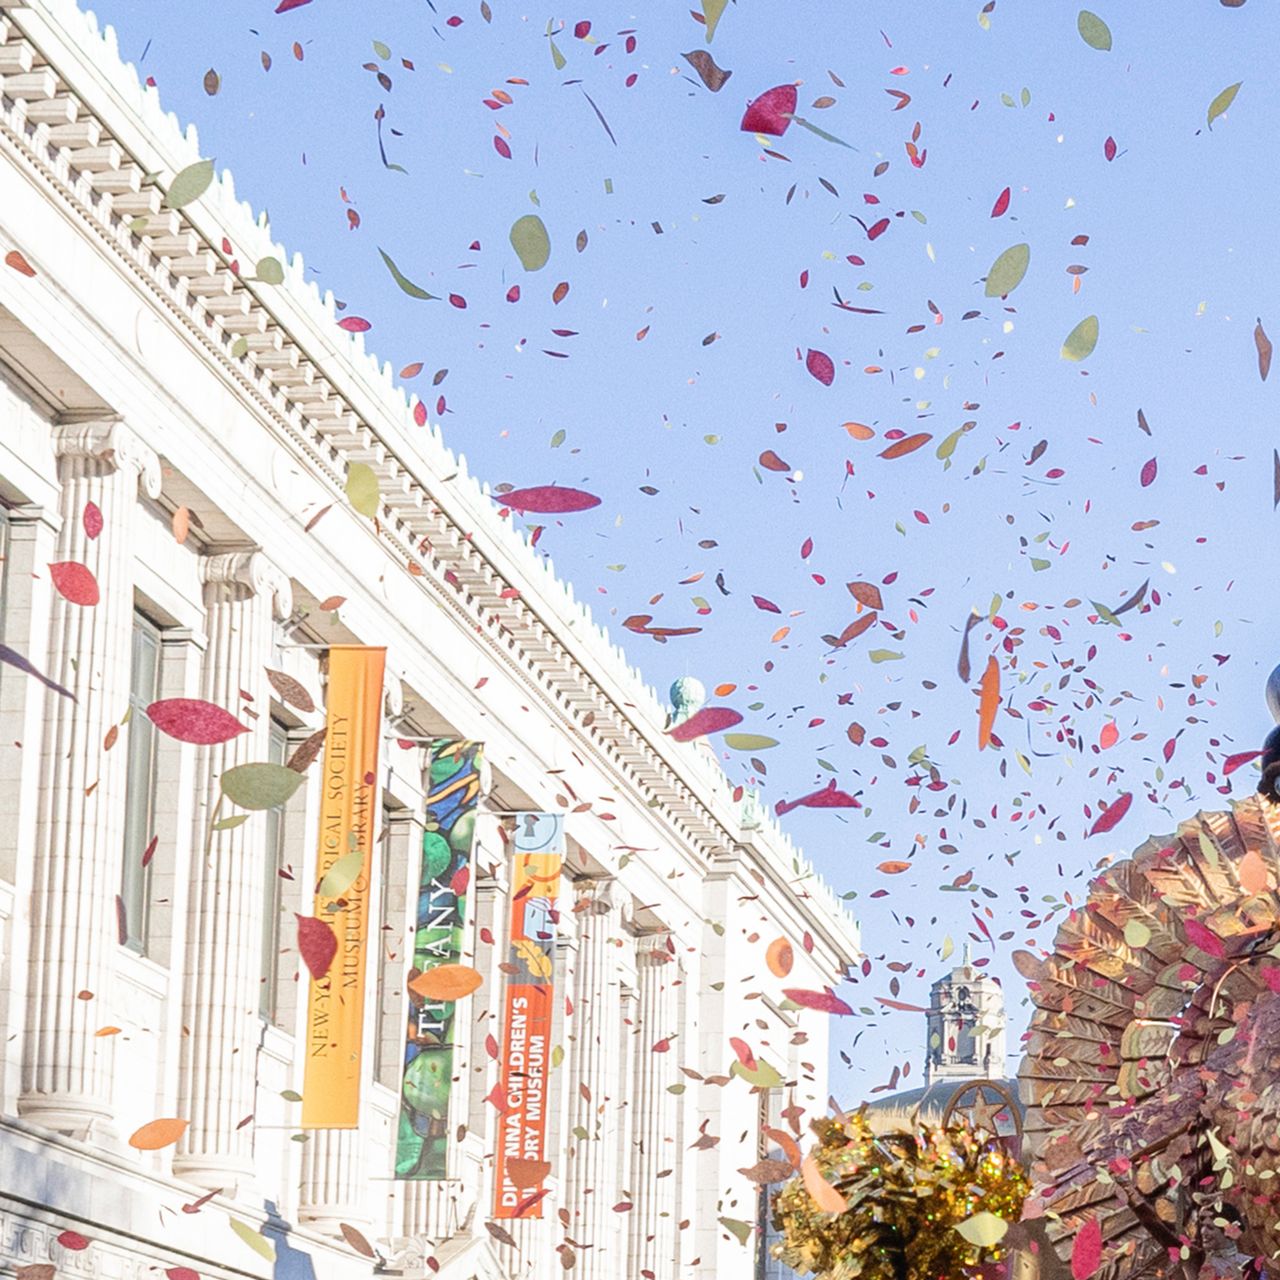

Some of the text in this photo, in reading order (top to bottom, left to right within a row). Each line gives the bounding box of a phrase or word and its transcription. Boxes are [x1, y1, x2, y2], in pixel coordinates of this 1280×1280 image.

[312, 970, 332, 1058] NEW-YO
[327, 713, 350, 800] SOCIETY
[342, 896, 362, 989] MUSEUM
[502, 996, 529, 1207] DINNA CHILDREN'S
[526, 1035, 545, 1121] MUSEUM
